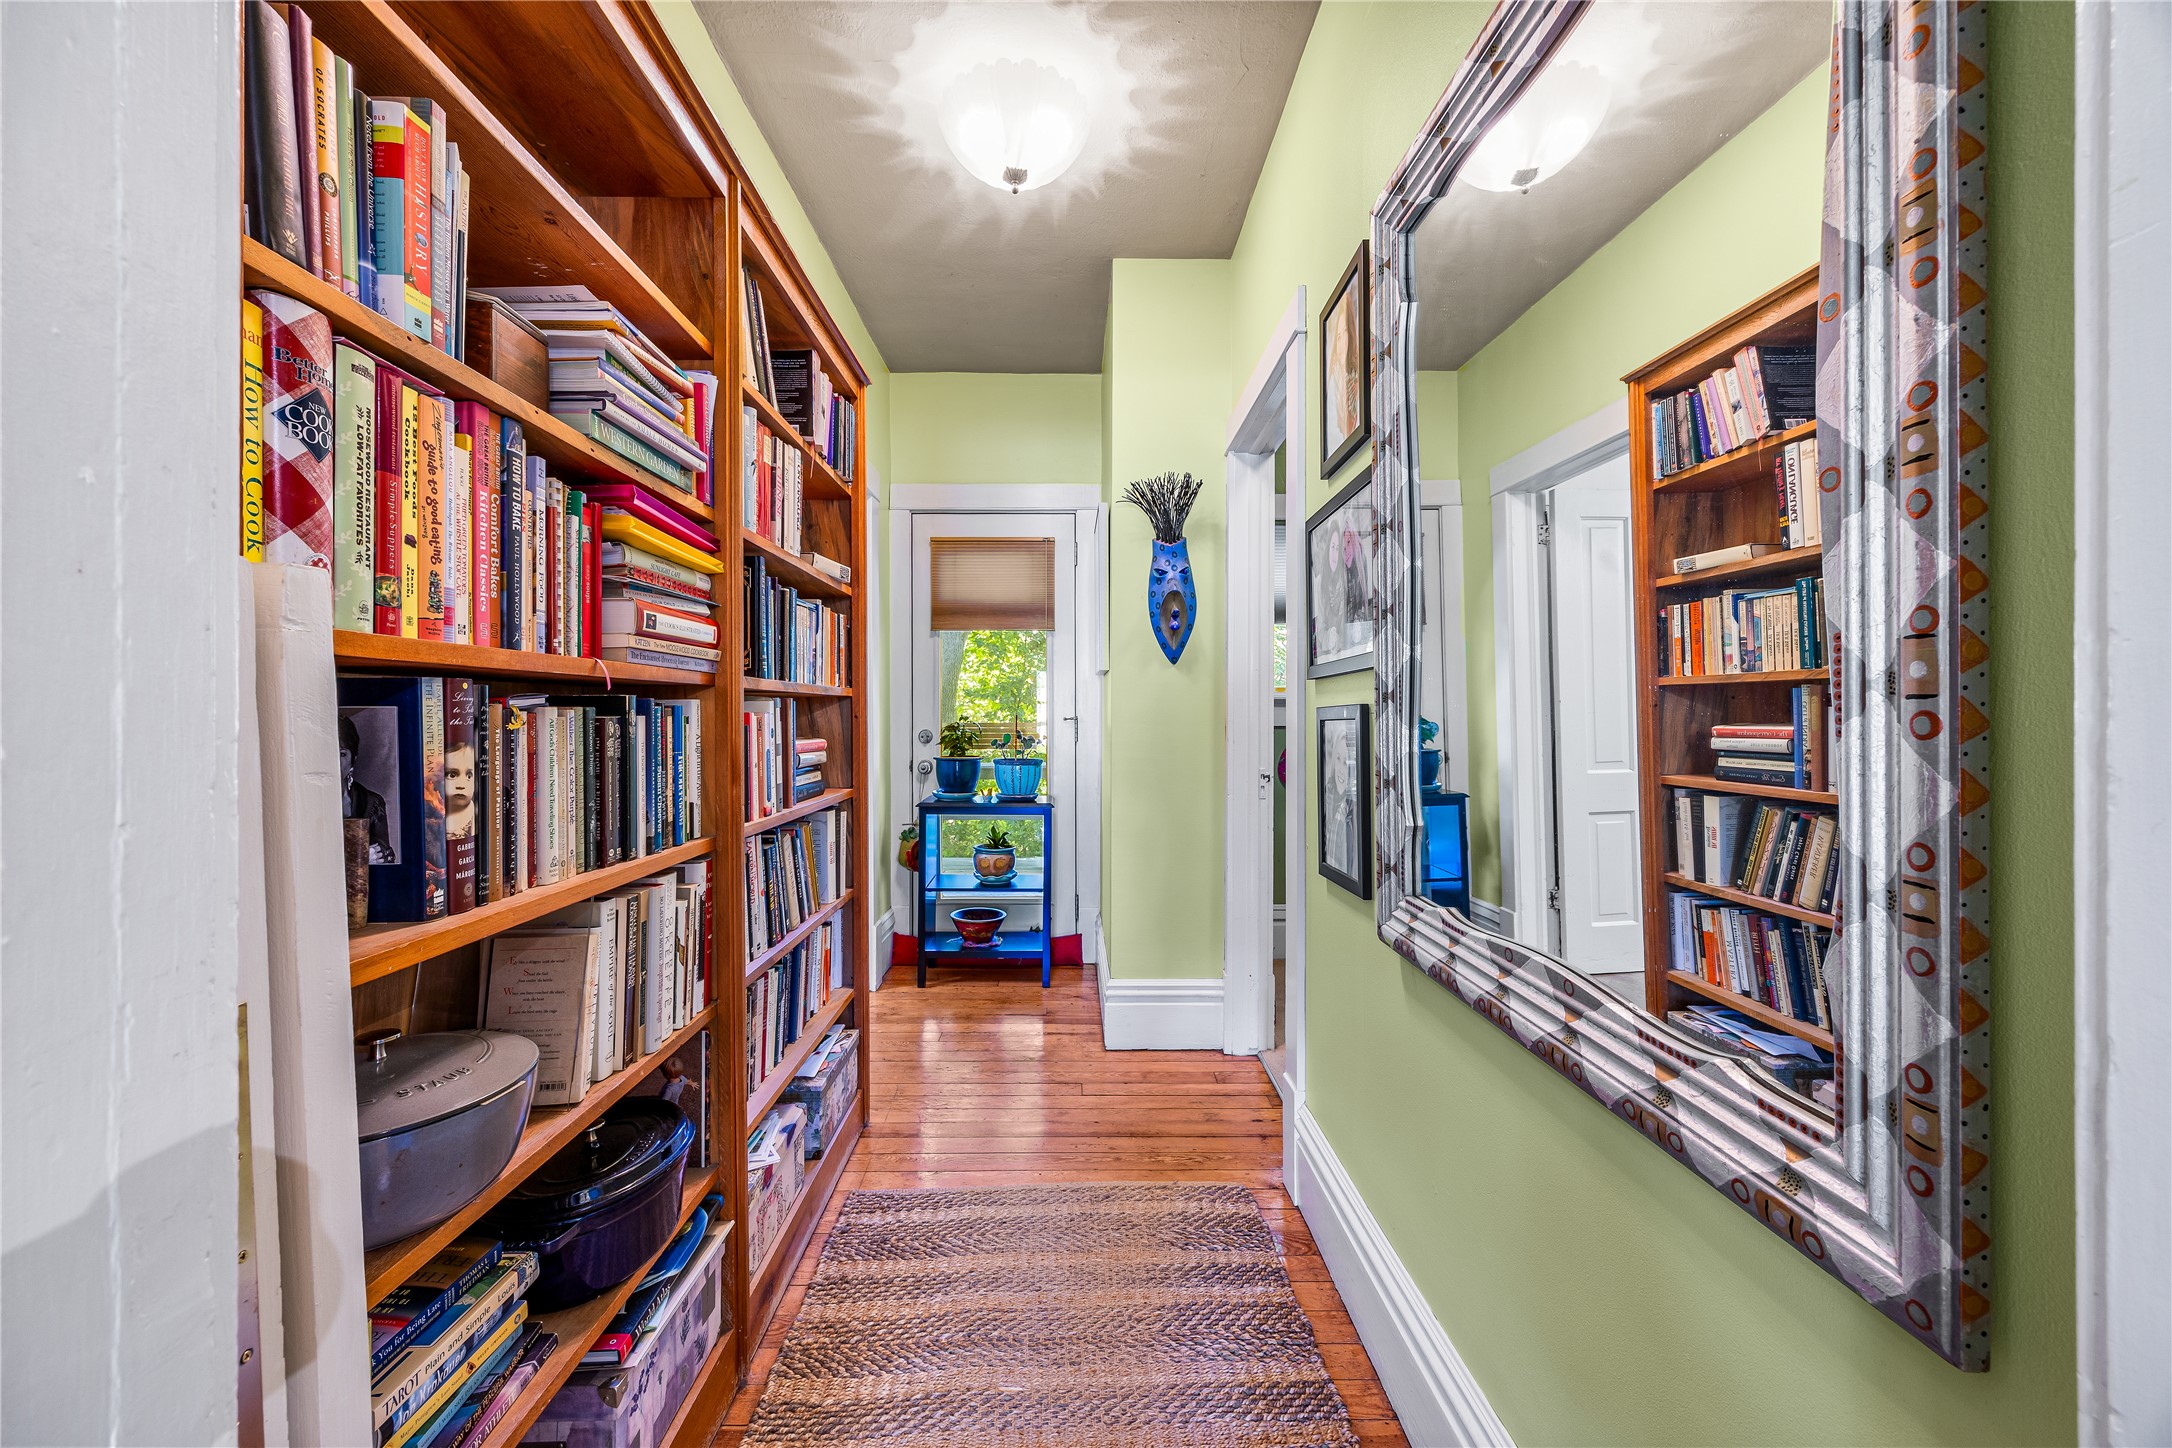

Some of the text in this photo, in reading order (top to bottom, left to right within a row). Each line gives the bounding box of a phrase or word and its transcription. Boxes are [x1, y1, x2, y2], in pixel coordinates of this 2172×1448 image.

[315, 67, 327, 150] OF SOCRATES
[366, 114, 374, 144] Notes
[367, 145, 375, 170] from
[324, 210, 332, 247] PHILLIPS
[368, 188, 376, 230] Universe
[413, 181, 429, 276] HISTORY
[434, 214, 443, 304] SACRED STORIES
[273, 346, 328, 377] Better
[308, 401, 328, 414] NEW
[412, 403, 418, 417] 12
[244, 437, 262, 466] to
[600, 422, 679, 481] WESTERN GARDEN
[356, 424, 364, 546] LOW-FAT FAVORITES
[422, 439, 443, 565] guide to good eating
[511, 457, 522, 532] HOW TO BAKE
[244, 477, 263, 553] Cook
[364, 488, 372, 571] RESTAURANT
[388, 480, 398, 570] Simple Suppers
[478, 489, 489, 552] Kitchen
[490, 493, 500, 554] Comfort
[478, 553, 488, 612] Classics
[490, 556, 500, 598] Bakes
[630, 650, 639, 660] The
[639, 651, 660, 663] Enchanted
[634, 638, 651, 647] KATZEN
[425, 683, 435, 773] THE INFINITE PLAN
[607, 983, 614, 991] of
[396, 1067, 472, 1099] STAUB
[458, 1264, 482, 1287] THOMAS
[458, 1264, 490, 1296] FRIEDMAN
[379, 1299, 441, 1360] You for Being Late
[382, 1282, 516, 1417] TAROT Plain and Simple Louis
[398, 1348, 466, 1426] Jon Krakauer
[464, 1419, 474, 1431] OF
[473, 1407, 483, 1420] THE
[482, 1379, 503, 1409] PEACEFUL
[503, 1348, 525, 1380] WARRIOR
[484, 1392, 519, 1434] ATHLETE
[399, 1425, 415, 1440] Major
